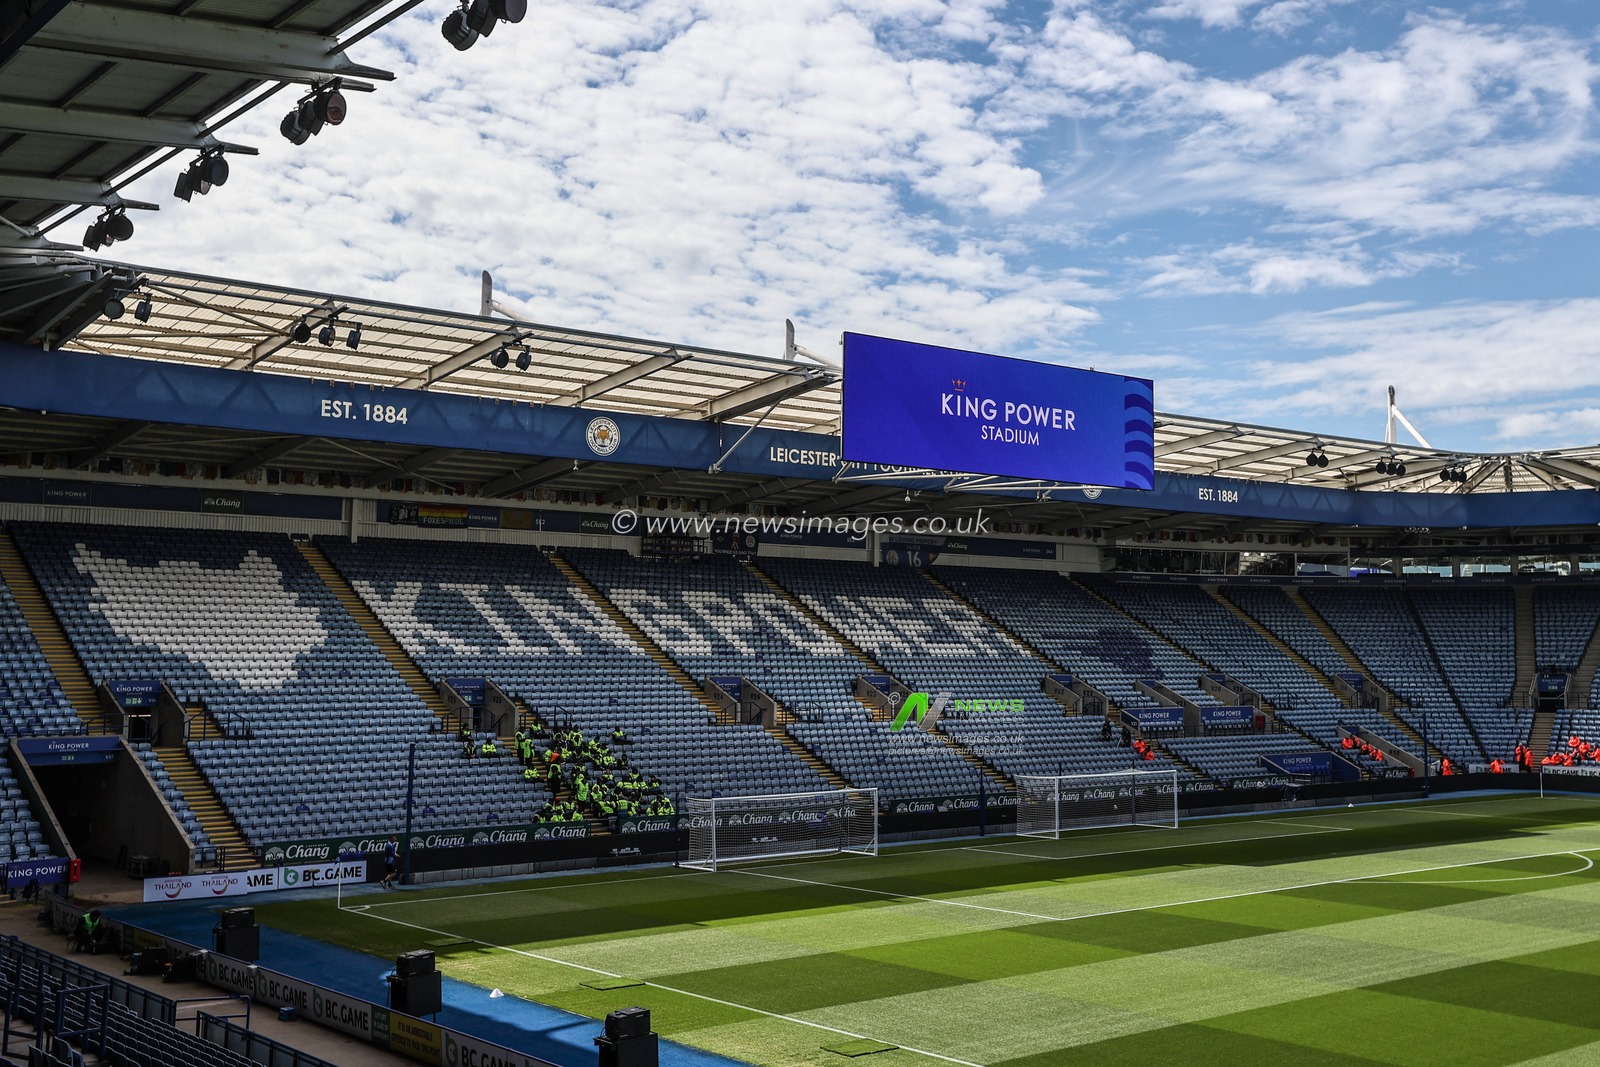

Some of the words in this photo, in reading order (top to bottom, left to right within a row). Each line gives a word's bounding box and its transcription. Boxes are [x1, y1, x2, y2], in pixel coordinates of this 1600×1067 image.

[321, 399, 357, 420] EST.
[363, 403, 408, 425] 1884
[941, 392, 998, 421] KING
[1004, 401, 1076, 431] POWER
[980, 424, 1040, 446] STADIUM
[770, 446, 837, 467] LEICESTER
[215, 497, 241, 508] Chang
[1198, 487, 1216, 501] EST.
[1217, 489, 1239, 503] 1884
[590, 519, 610, 530] Chang
[953, 542, 968, 550] Chang
[907, 551, 922, 567] 16
[1295, 756, 1312, 764] POWER
[1194, 781, 1214, 792] Chang
[1094, 789, 1115, 800] Chang
[908, 801, 935, 812] Chang
[550, 826, 586, 838] Chang
[637, 819, 671, 832] Chang
[425, 834, 466, 849] Chang
[489, 830, 528, 843] Chang
[285, 843, 330, 859] Chang
[7, 868, 33, 879] KING
[35, 864, 69, 876] POWER
[302, 866, 363, 882] BC.GAME
[154, 881, 192, 891] THAILAND
[201, 878, 239, 888] THAILAND
[218, 963, 254, 991] BC.GAME
[269, 980, 308, 1010] BC.GAME
[325, 999, 369, 1032] BC.GAME
